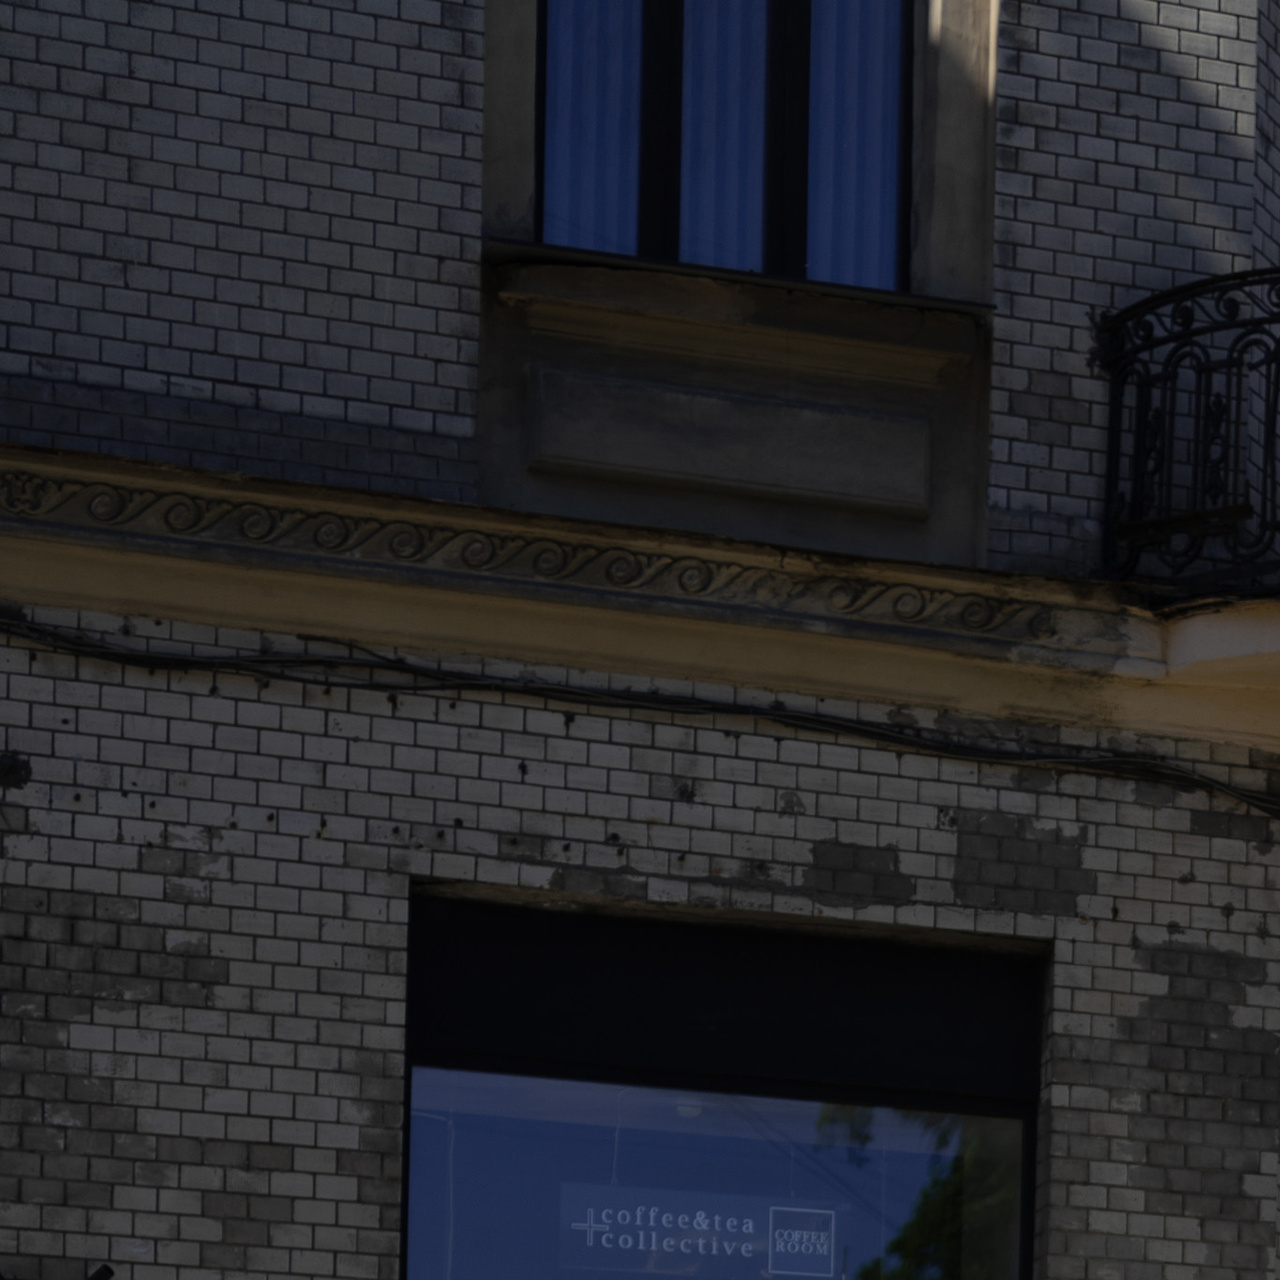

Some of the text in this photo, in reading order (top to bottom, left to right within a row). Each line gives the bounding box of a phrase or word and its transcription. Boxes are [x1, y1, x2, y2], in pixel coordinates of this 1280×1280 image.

[601, 1206, 755, 1234] coffee&tea
[600, 1231, 754, 1257] collective
[774, 1229, 830, 1244] COFFEE
[775, 1240, 829, 1255] ROOM
